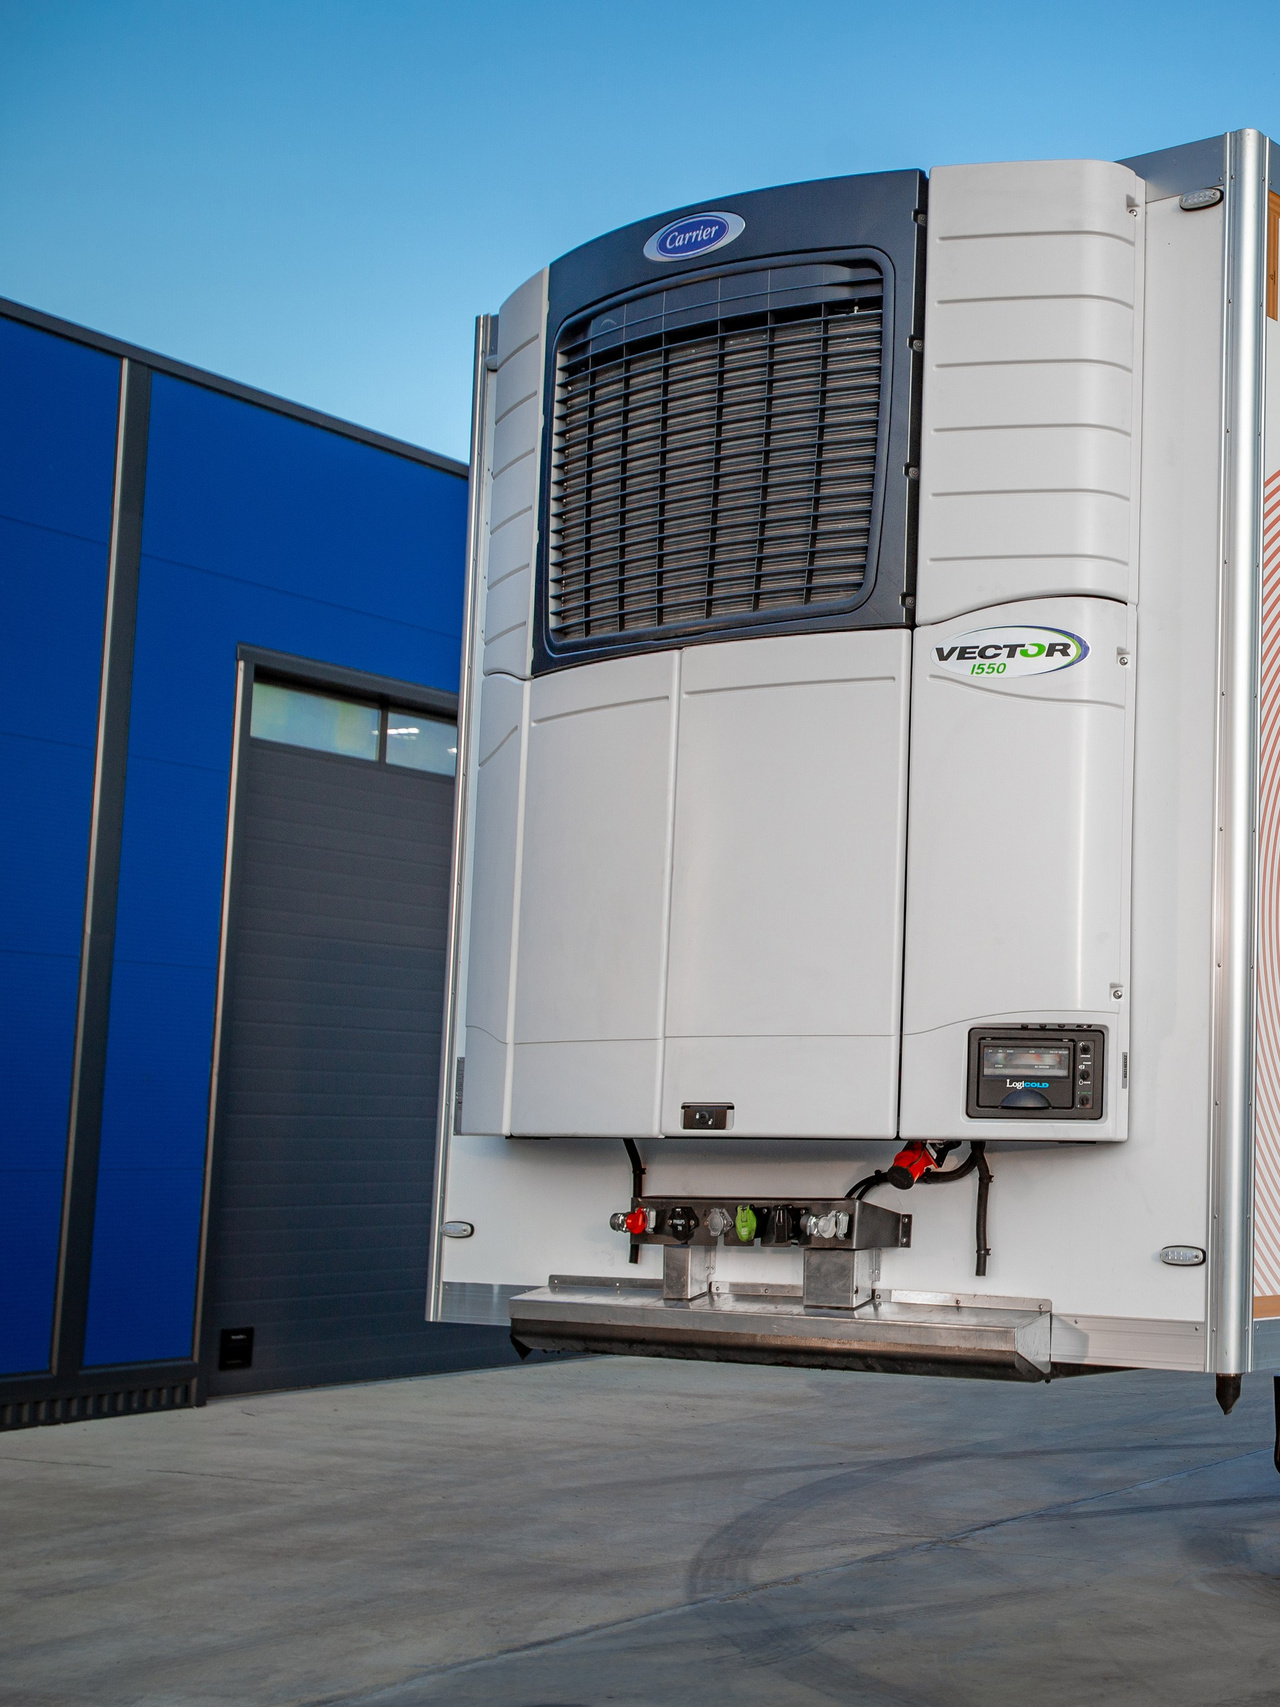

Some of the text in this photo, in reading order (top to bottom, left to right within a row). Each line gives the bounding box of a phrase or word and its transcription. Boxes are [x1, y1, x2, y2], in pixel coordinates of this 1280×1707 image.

[666, 225, 719, 249] Carrier
[935, 642, 1071, 661] VECTOR
[1006, 1079, 1049, 1089] LogiCOLD
